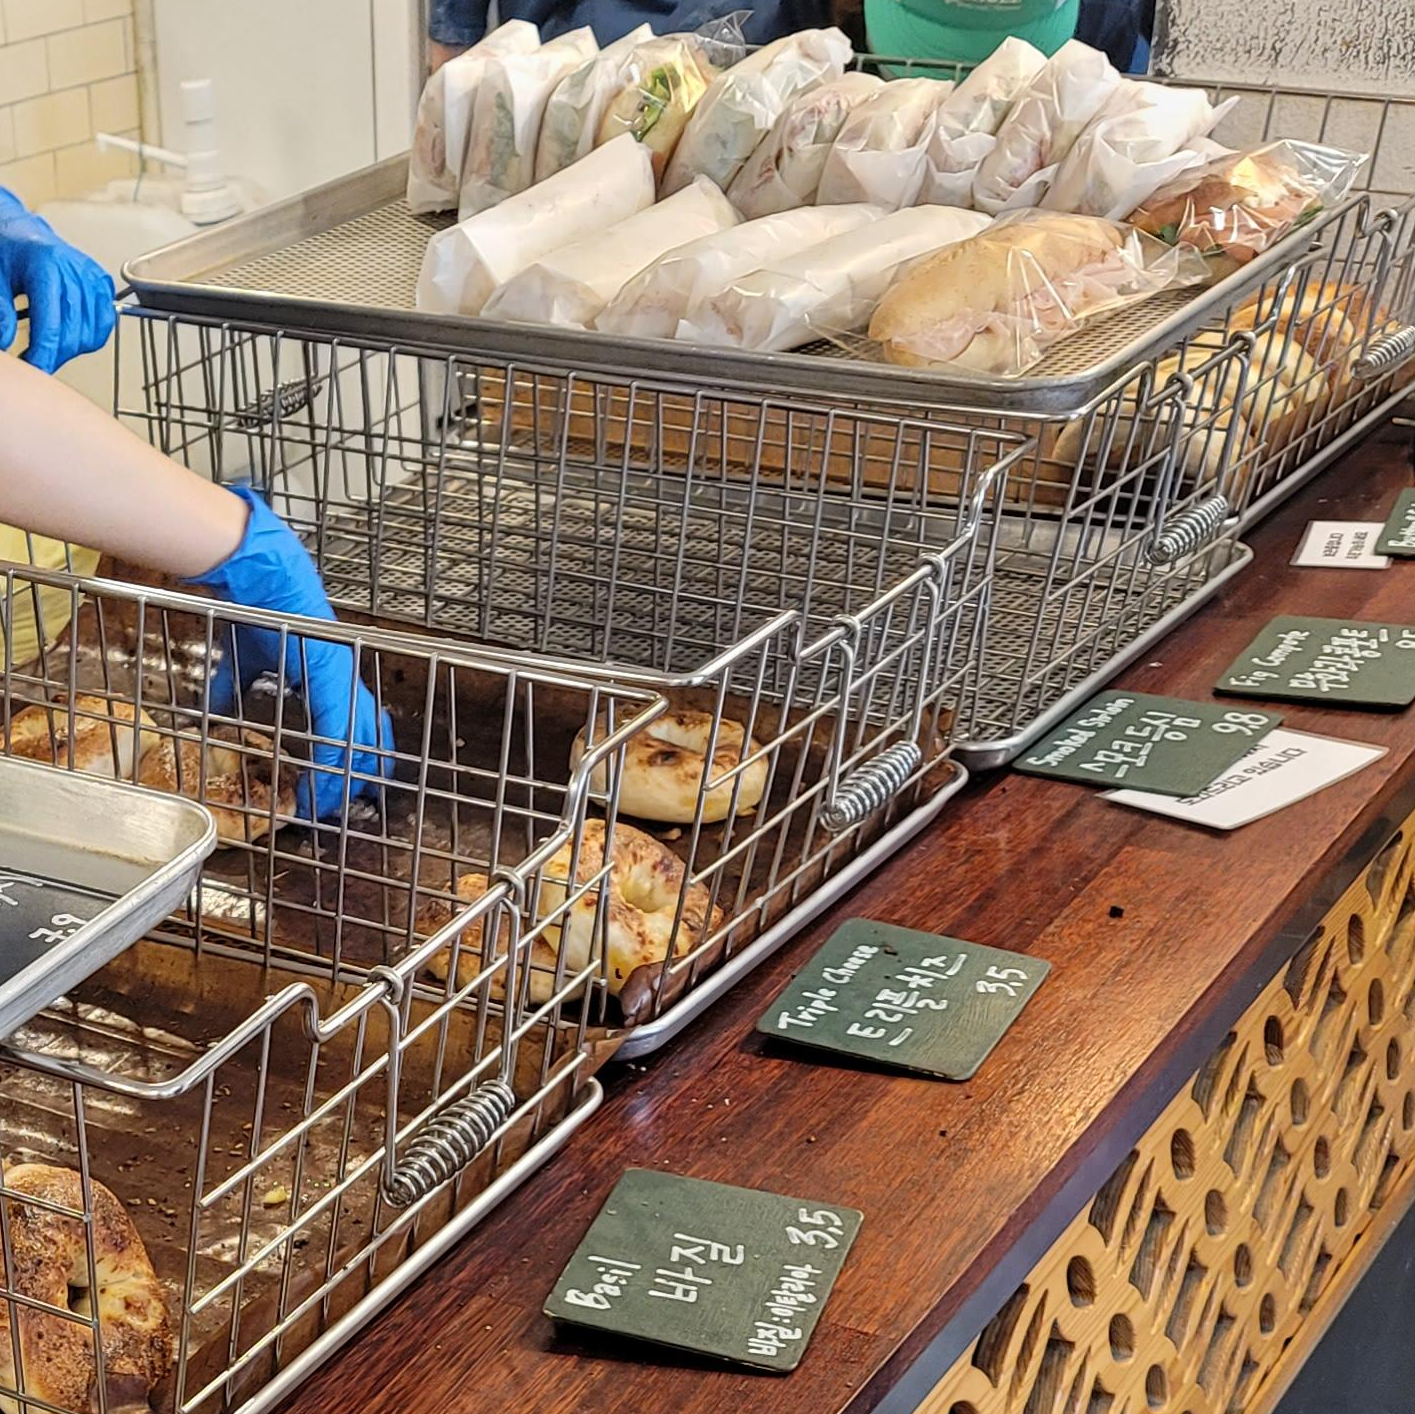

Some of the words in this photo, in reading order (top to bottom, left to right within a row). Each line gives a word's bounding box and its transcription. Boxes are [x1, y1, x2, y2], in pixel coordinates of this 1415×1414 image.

[1026, 722, 1096, 767] Smoked
[1243, 748, 1307, 775] 있습니다
[778, 989, 839, 1031] Triple
[564, 1254, 642, 1311] Basil
[648, 1232, 745, 1304] 바질
